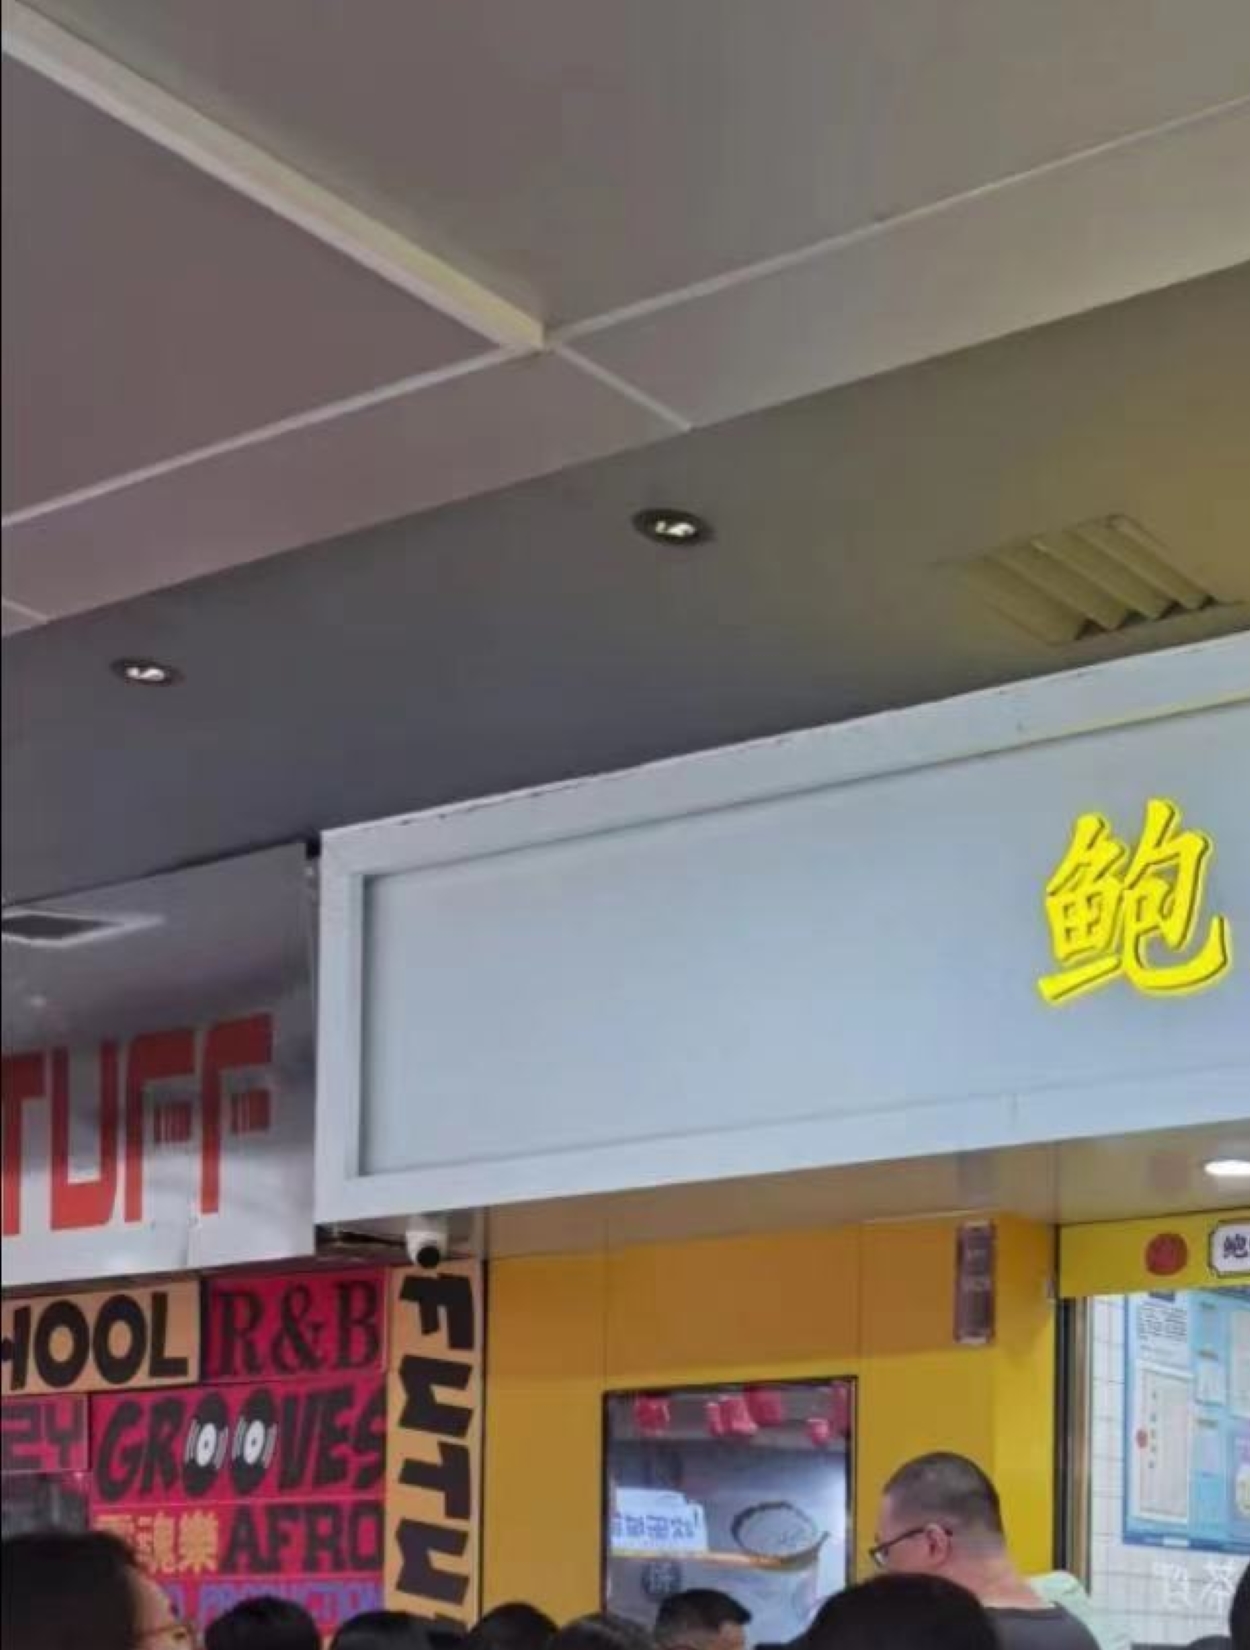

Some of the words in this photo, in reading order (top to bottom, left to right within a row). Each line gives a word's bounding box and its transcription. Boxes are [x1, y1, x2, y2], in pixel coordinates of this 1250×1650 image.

[218, 1280, 380, 1376] R&B
[99, 1381, 385, 1503] GROOVES
[220, 1503, 383, 1573] AFRO
